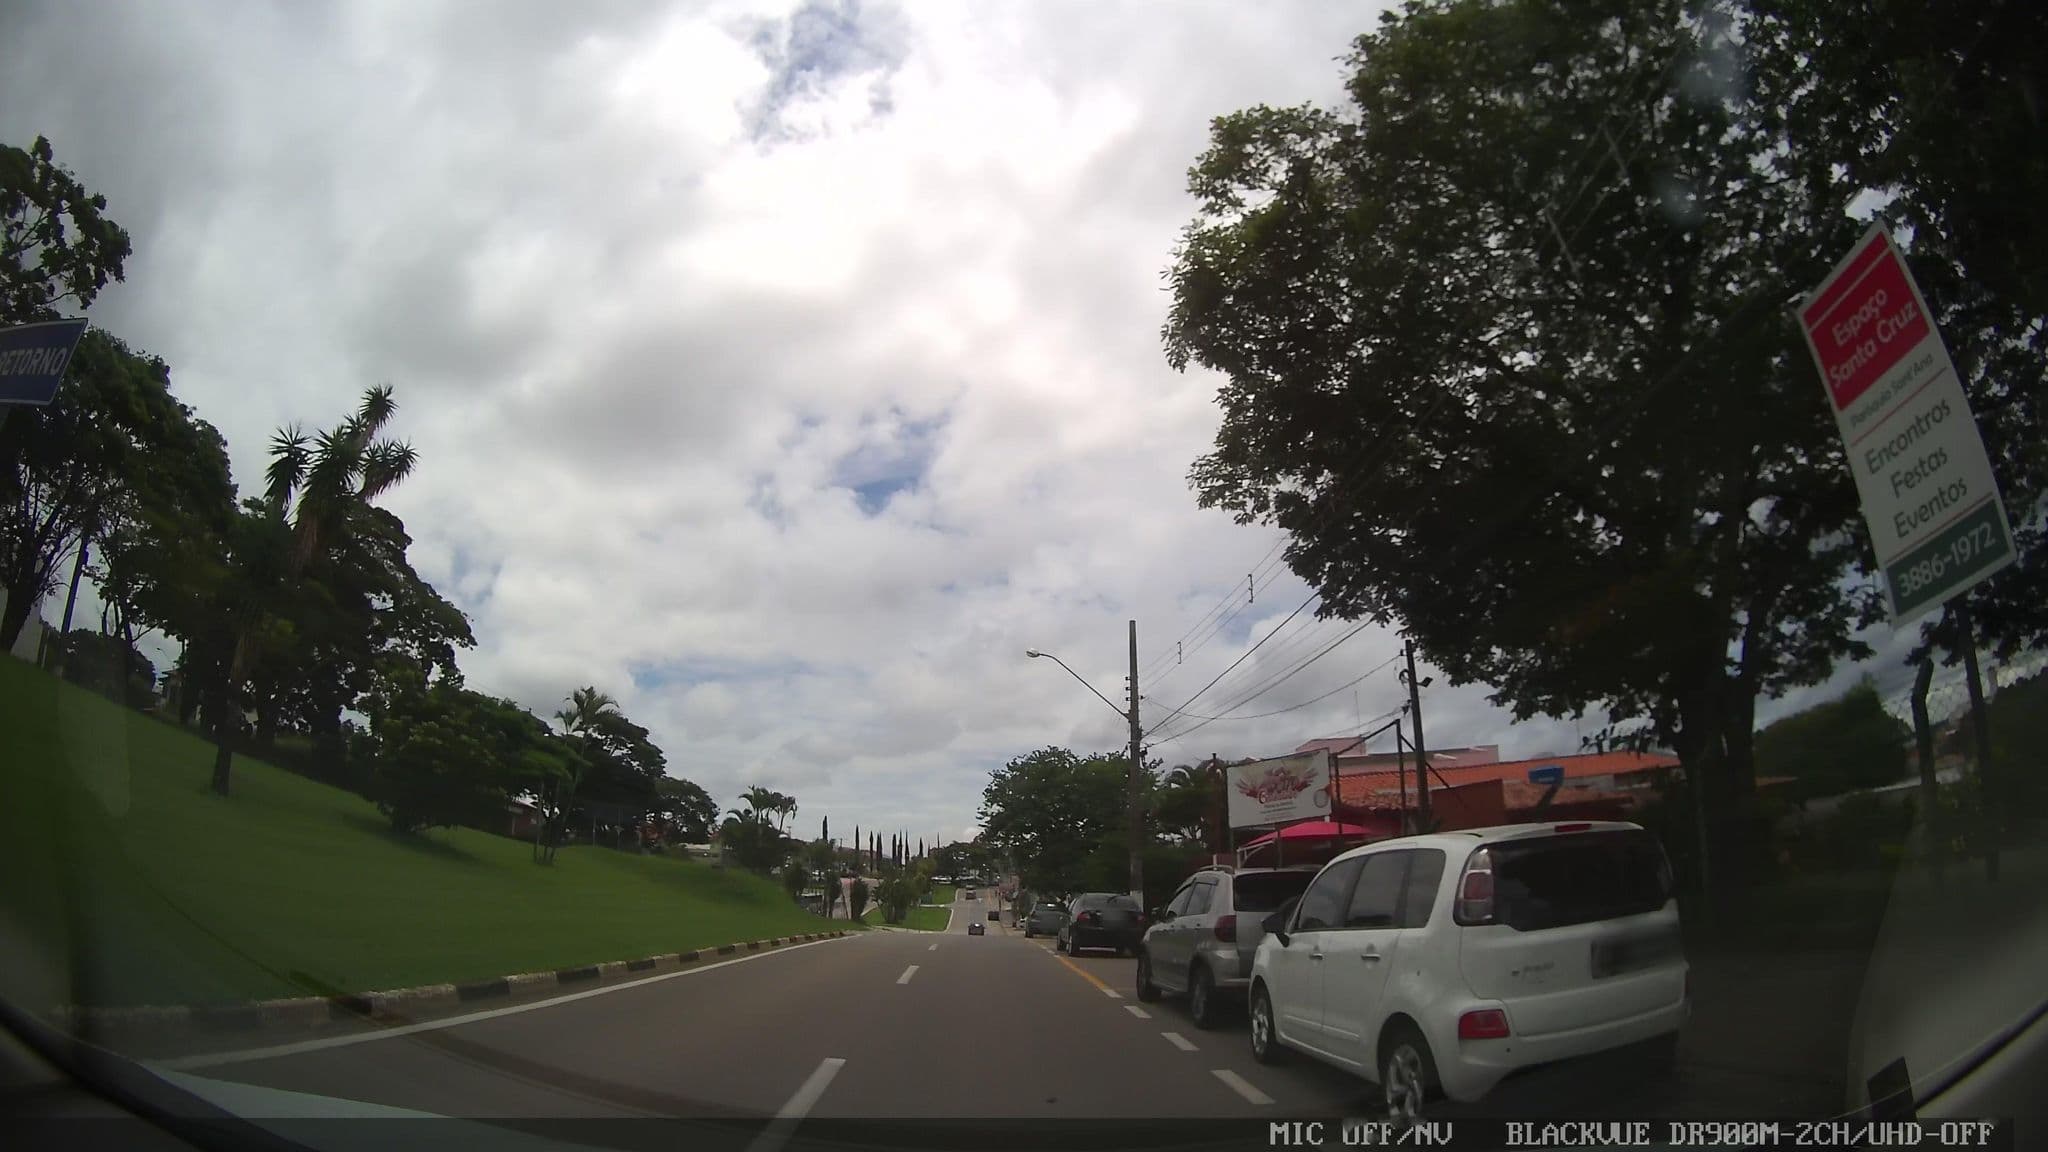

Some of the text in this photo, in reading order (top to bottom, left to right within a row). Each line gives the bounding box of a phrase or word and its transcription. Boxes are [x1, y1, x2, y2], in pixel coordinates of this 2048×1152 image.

[1830, 302, 1917, 387] Santa Cruz
[1832, 289, 1887, 345] Espaço
[1865, 399, 1950, 474] Encontros
[1891, 447, 1948, 498] Festas
[1894, 478, 1967, 538] Eventos
[1899, 522, 1996, 597] 3886-1972
